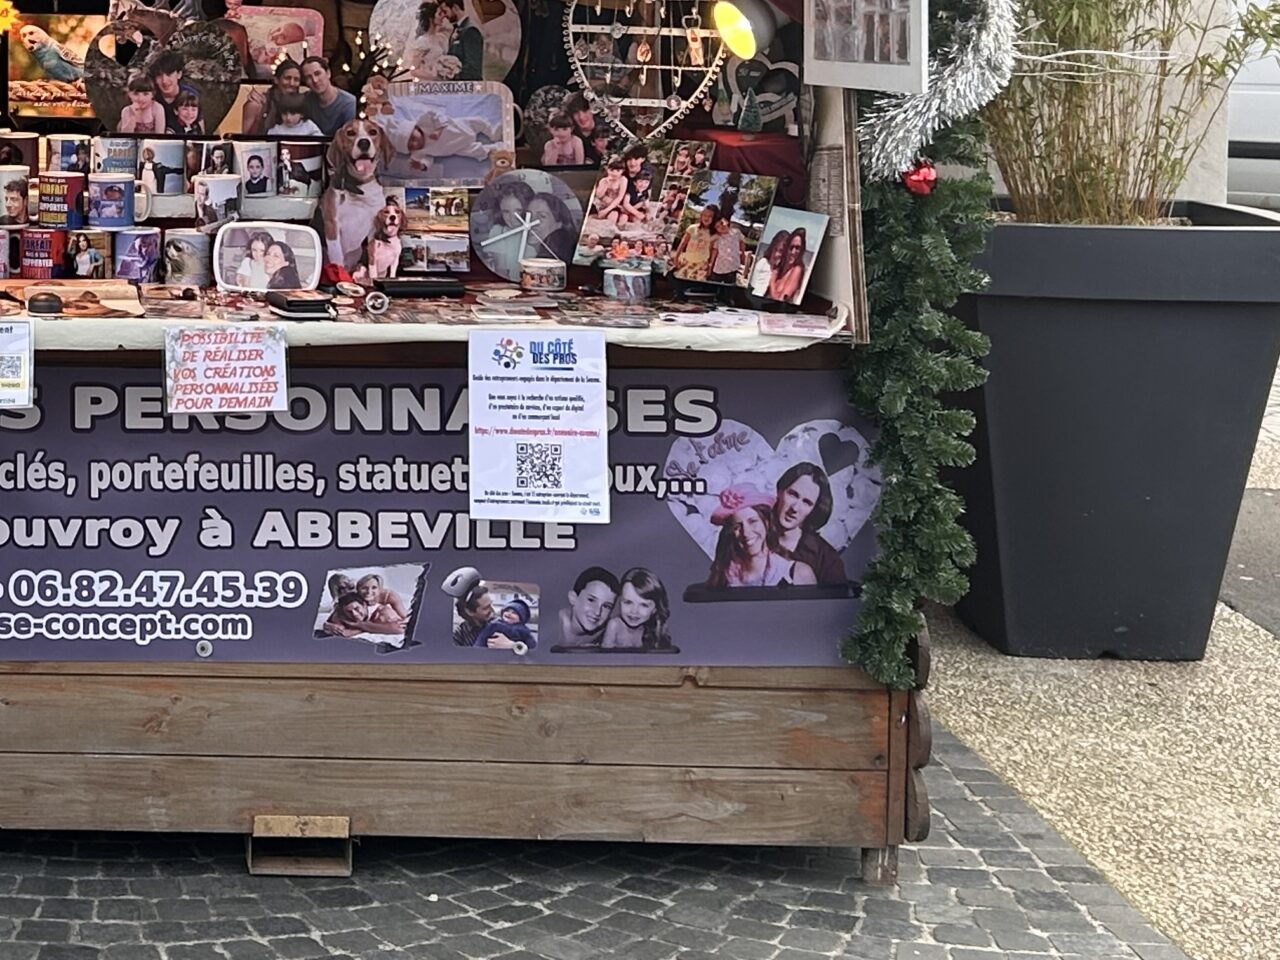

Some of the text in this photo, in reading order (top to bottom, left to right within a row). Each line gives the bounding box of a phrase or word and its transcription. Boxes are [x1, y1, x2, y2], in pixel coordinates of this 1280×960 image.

[419, 82, 474, 95] MAXIME
[180, 327, 265, 346] POSSIBILITÉ
[182, 346, 264, 362] DE RÉALISER
[530, 338, 573, 354] DU CÔTÉ
[532, 353, 577, 365] DES PROS
[172, 363, 277, 381] VOS CRÉATIONS
[174, 378, 279, 395] PERSONNALISÉES
[74, 386, 718, 433] PEONNAES
[175, 396, 273, 410] POUR DEMAIN
[90, 454, 326, 498] portefeuilles,
[338, 456, 468, 492] statuet
[608, 463, 706, 498] ux,...
[199, 507, 234, 548] à
[253, 510, 578, 550] ABBEVILLE
[8, 569, 309, 609] 06.82.47.45.39
